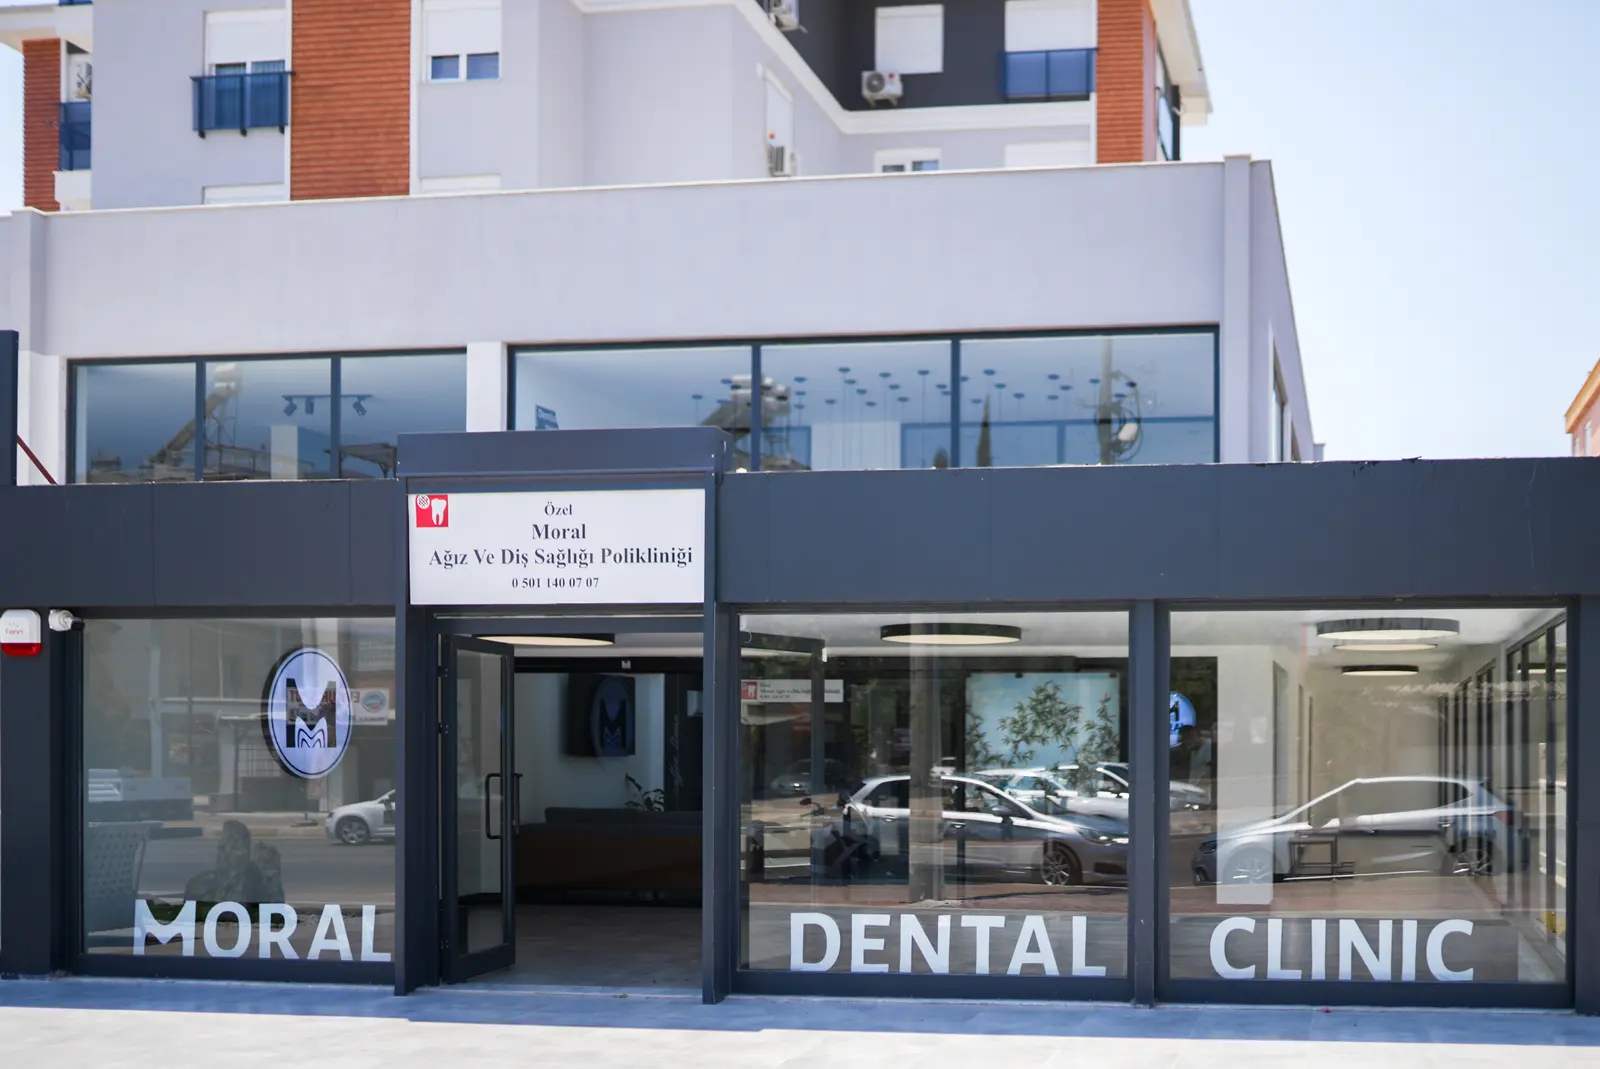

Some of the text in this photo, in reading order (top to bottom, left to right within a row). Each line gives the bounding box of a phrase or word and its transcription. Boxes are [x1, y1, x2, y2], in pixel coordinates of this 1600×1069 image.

[544, 501, 573, 516] Özel
[532, 524, 587, 540] Moral
[429, 547, 693, 569] Ağız Ve Diş Sağlığı Polikliniği
[511, 577, 599, 588] 0 501 140 07 07
[133, 899, 1474, 981] MORAL DENTAL CLINIC
